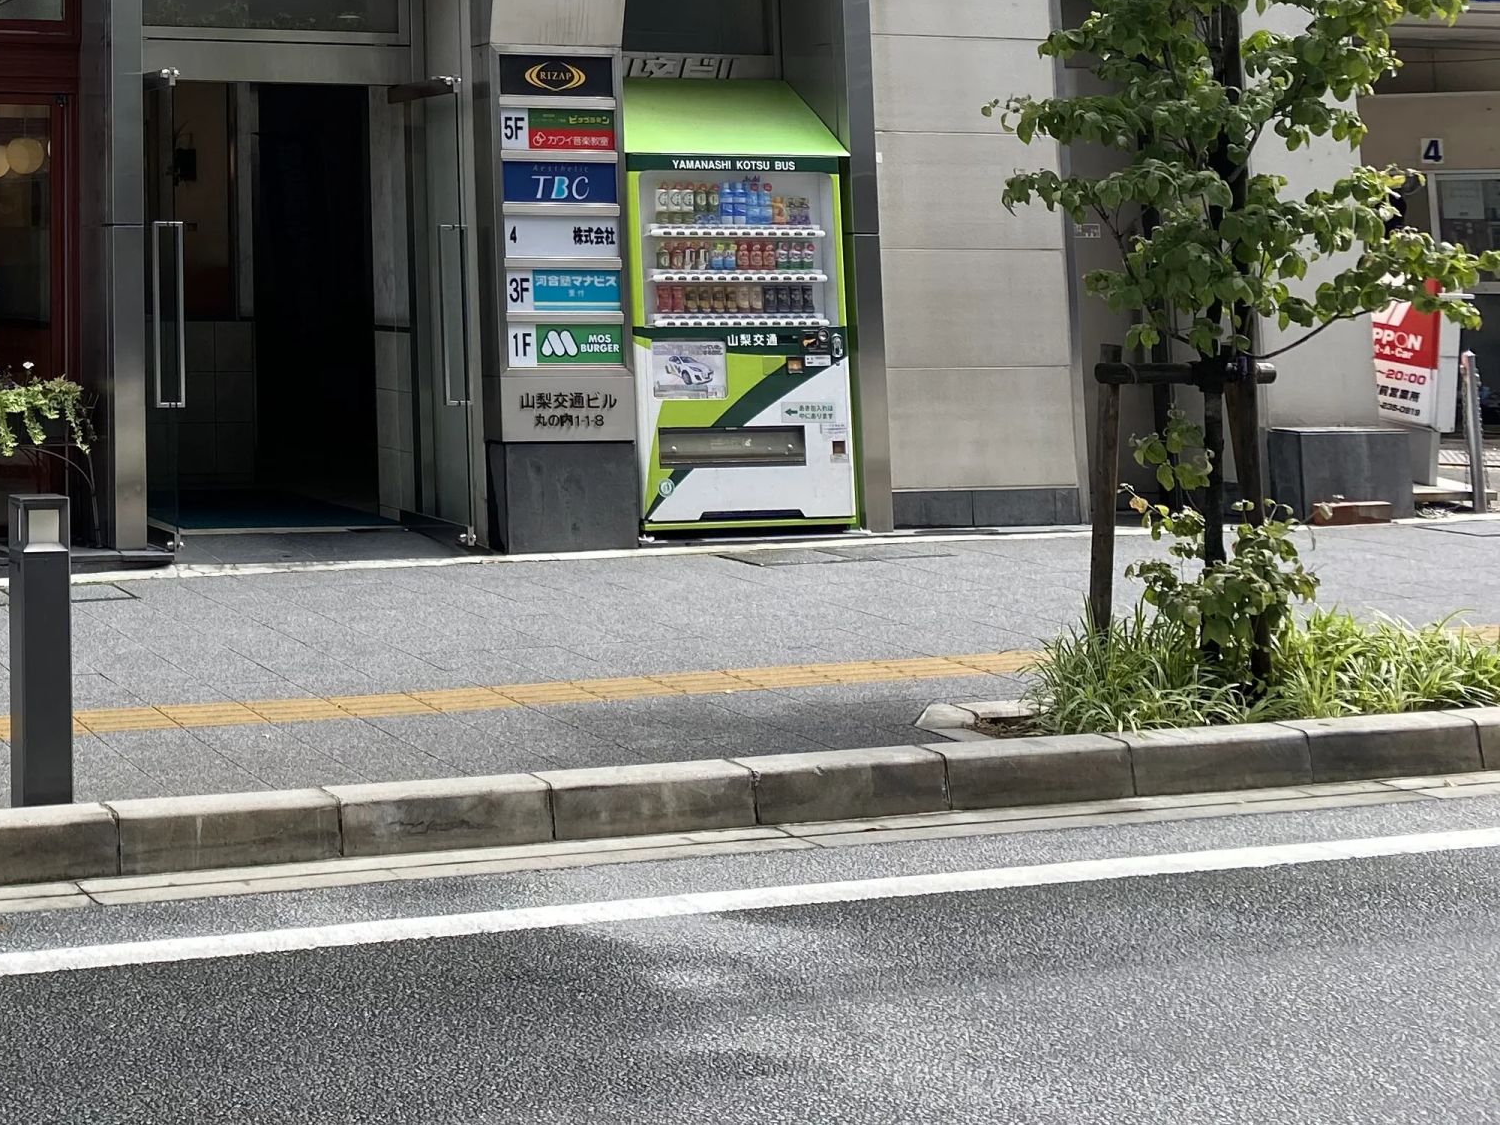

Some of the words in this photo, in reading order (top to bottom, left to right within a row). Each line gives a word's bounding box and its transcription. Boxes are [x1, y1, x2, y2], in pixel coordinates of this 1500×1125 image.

[539, 70, 573, 81] RIZAP
[503, 116, 525, 140] 5F
[547, 135, 609, 147] カワイ音楽教室
[1423, 139, 1442, 162] 4
[672, 159, 732, 170] YAMANASHI
[736, 160, 770, 170] KOTSU
[775, 160, 796, 171] BUS
[531, 175, 590, 200] TBC
[509, 226, 518, 244] 4
[572, 227, 616, 246] 株式会社
[535, 275, 618, 288] 河合塾マナビス
[509, 278, 530, 303] 3F
[512, 332, 532, 358] 1F
[588, 334, 612, 344] MOS
[726, 334, 779, 347] 山梨交通
[580, 343, 620, 353] BURGER
[519, 392, 618, 410] 山梨交通ビル
[534, 414, 605, 427] 丸の内1-1-8
